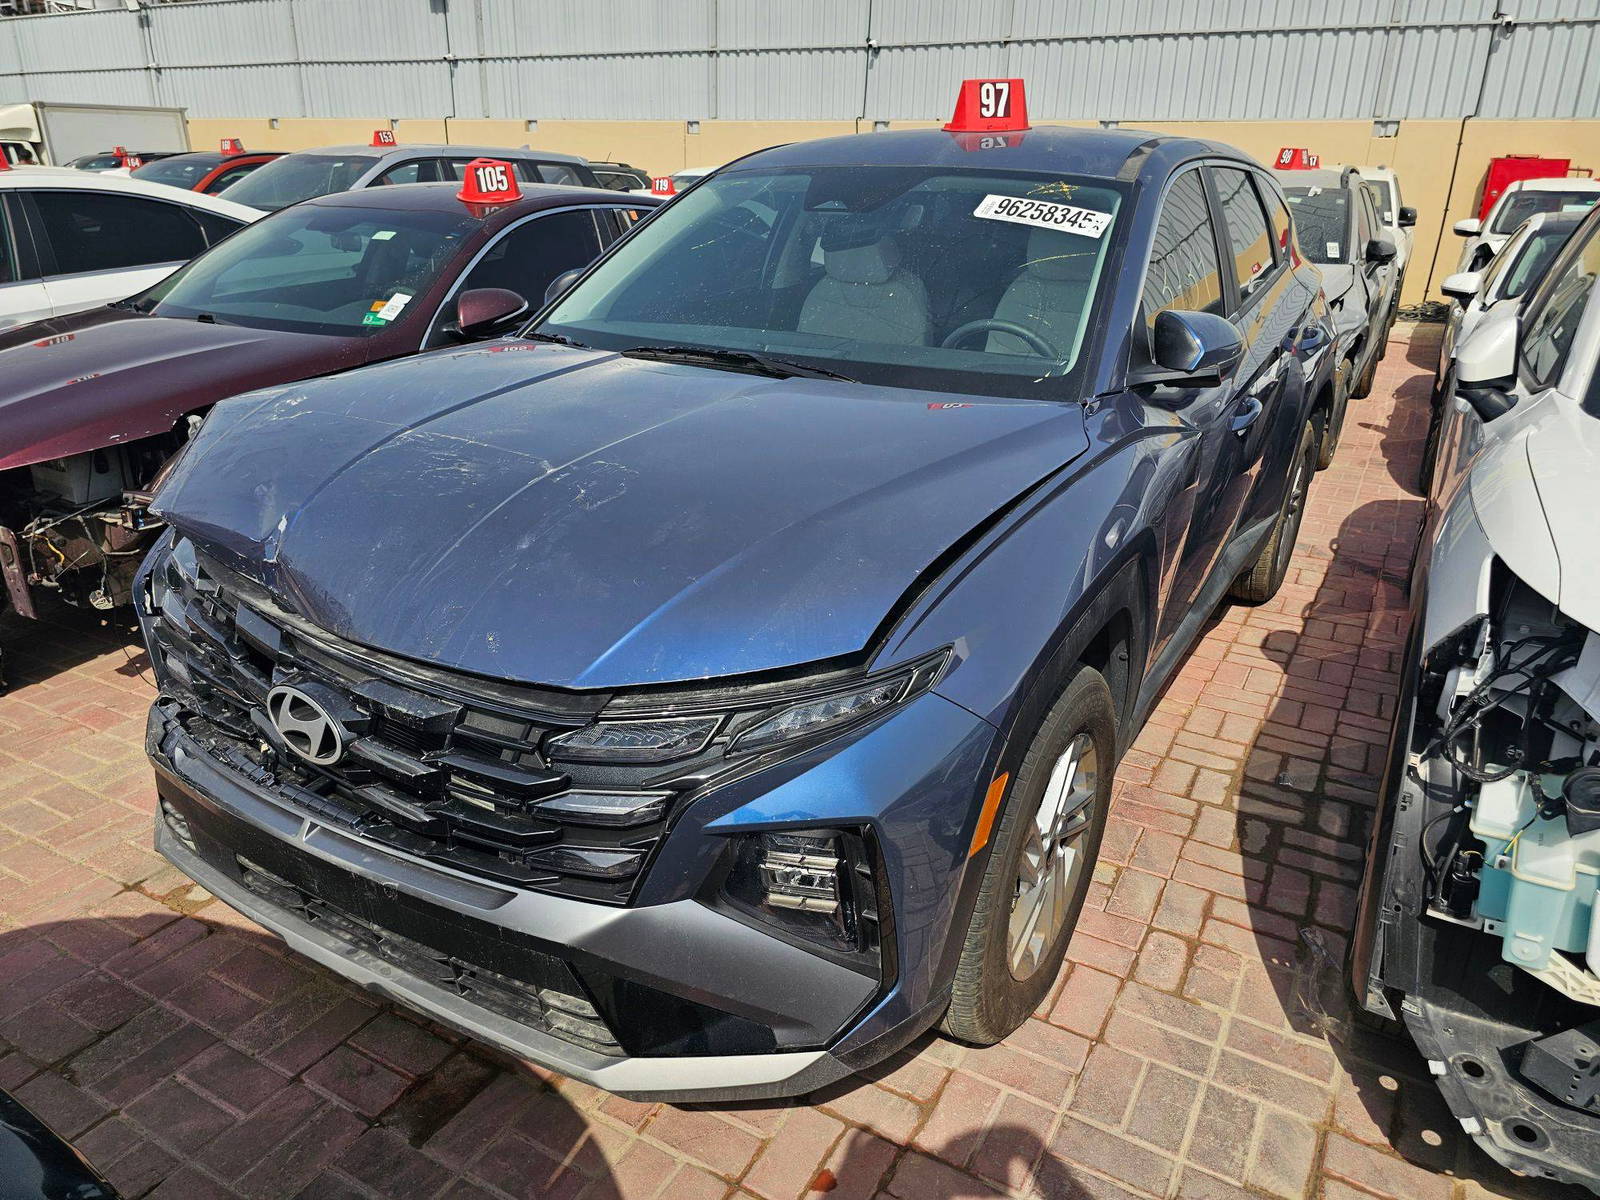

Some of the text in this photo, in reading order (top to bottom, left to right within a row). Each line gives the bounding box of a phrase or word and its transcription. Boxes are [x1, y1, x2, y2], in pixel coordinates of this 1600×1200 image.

[981, 82, 1009, 118] 97
[379, 131, 394, 143] 153
[476, 166, 509, 193] 105
[655, 179, 669, 191] 119
[994, 198, 1096, 229] 96258345
